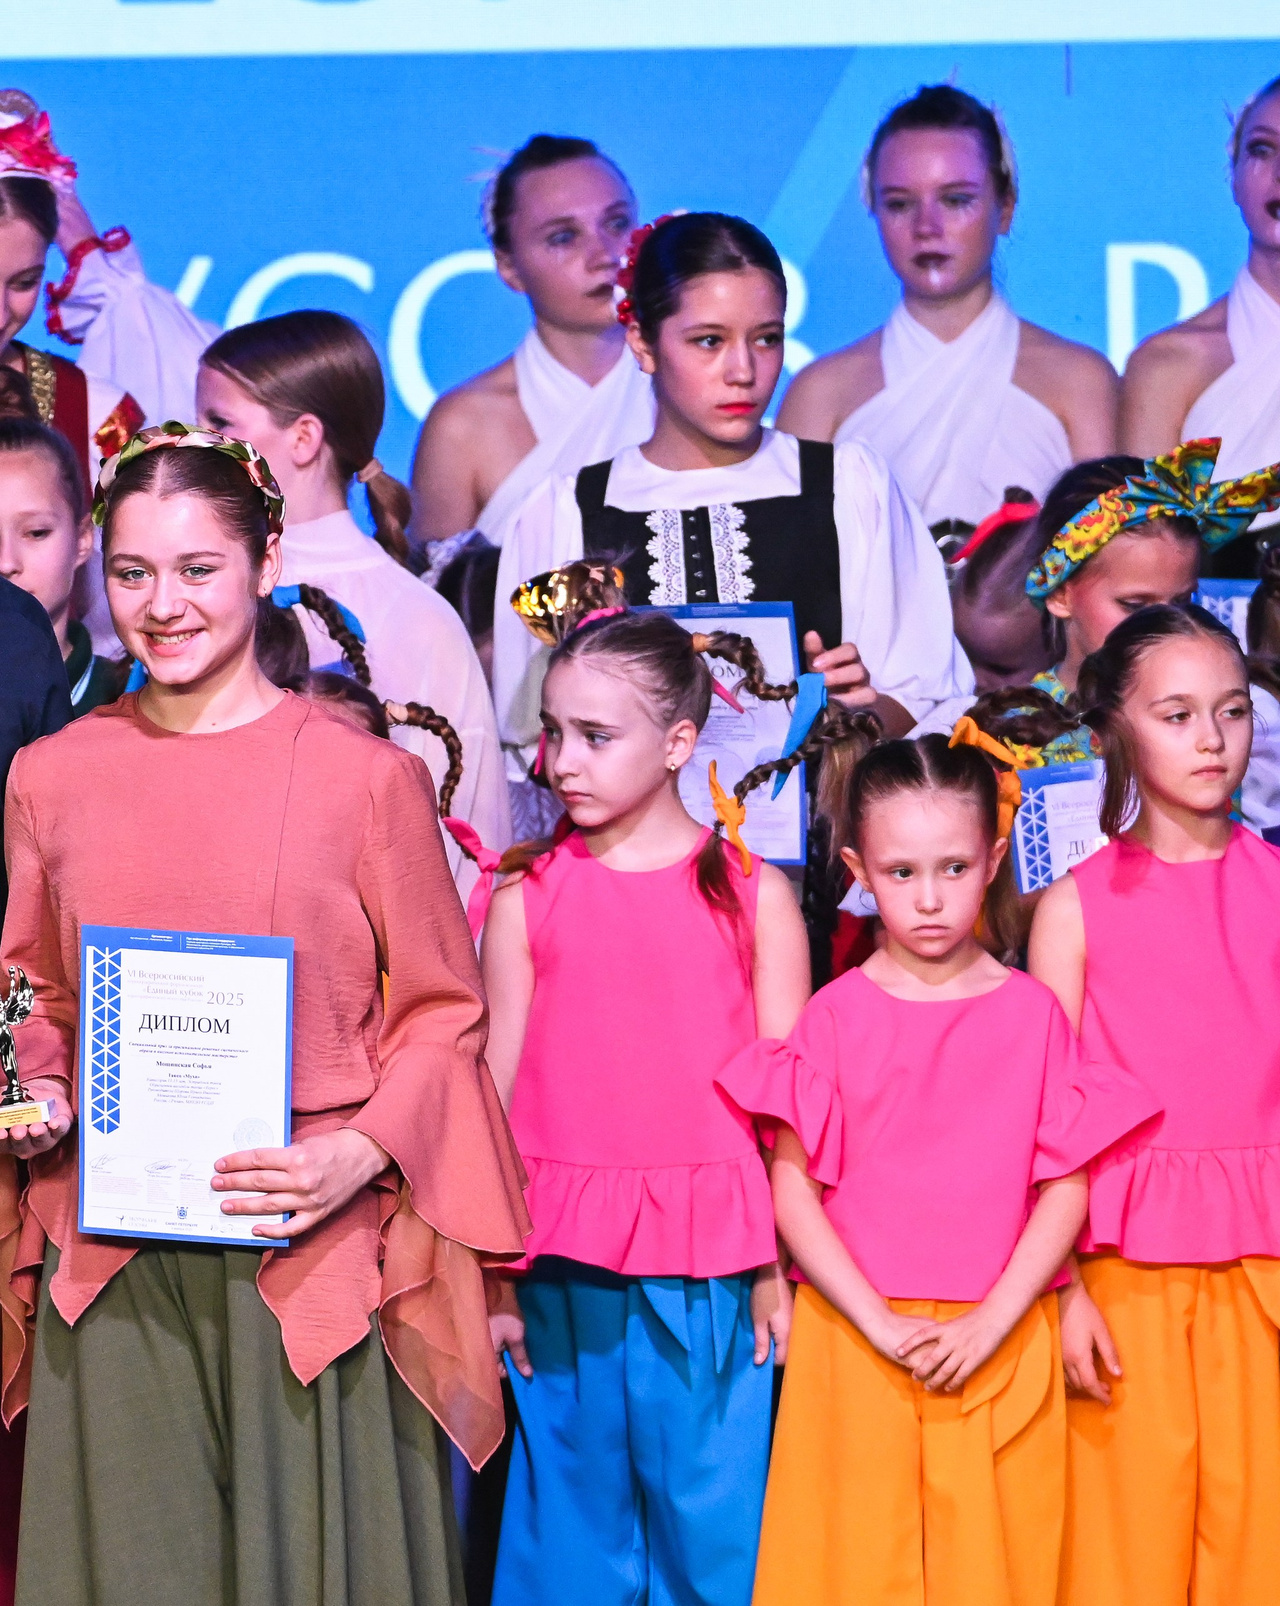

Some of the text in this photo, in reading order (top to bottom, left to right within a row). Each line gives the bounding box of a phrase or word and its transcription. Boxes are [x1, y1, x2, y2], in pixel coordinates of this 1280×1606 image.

[138, 970, 205, 983] Всероссийский
[207, 991, 245, 1006] 2025
[138, 1013, 231, 1035] ДИПЛОМ
